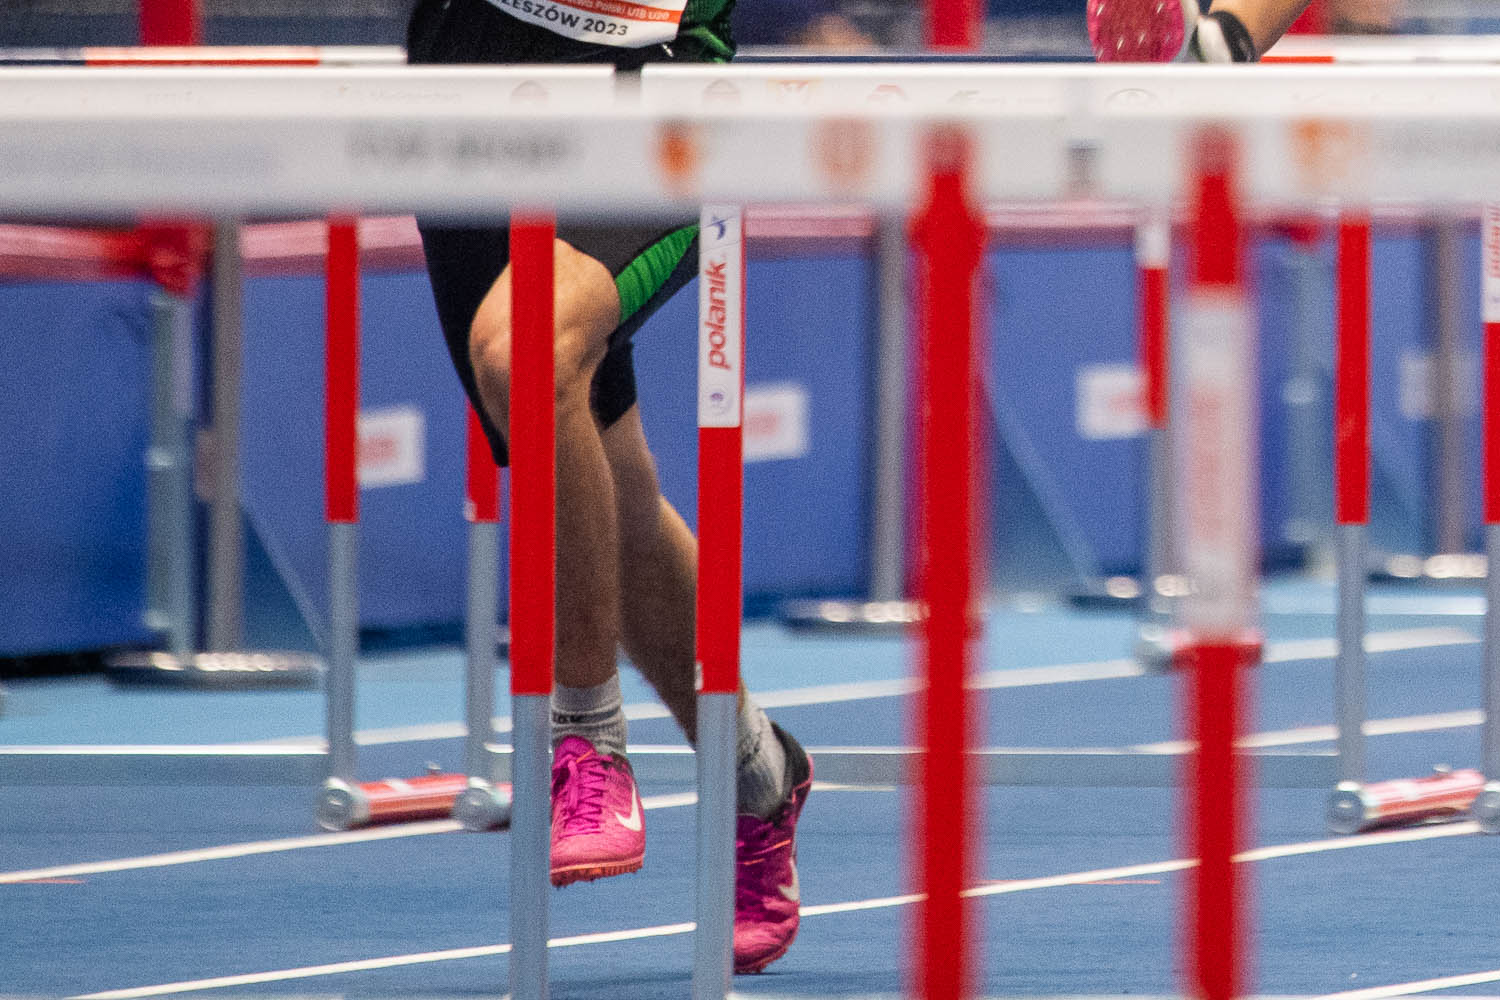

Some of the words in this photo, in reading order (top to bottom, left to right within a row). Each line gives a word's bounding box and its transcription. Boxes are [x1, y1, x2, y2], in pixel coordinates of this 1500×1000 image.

[595, 0, 626, 15] Polski
[626, 7, 647, 19] U18
[648, 10, 670, 21] U20
[583, 17, 629, 36] 2023
[704, 257, 732, 371] polanik
